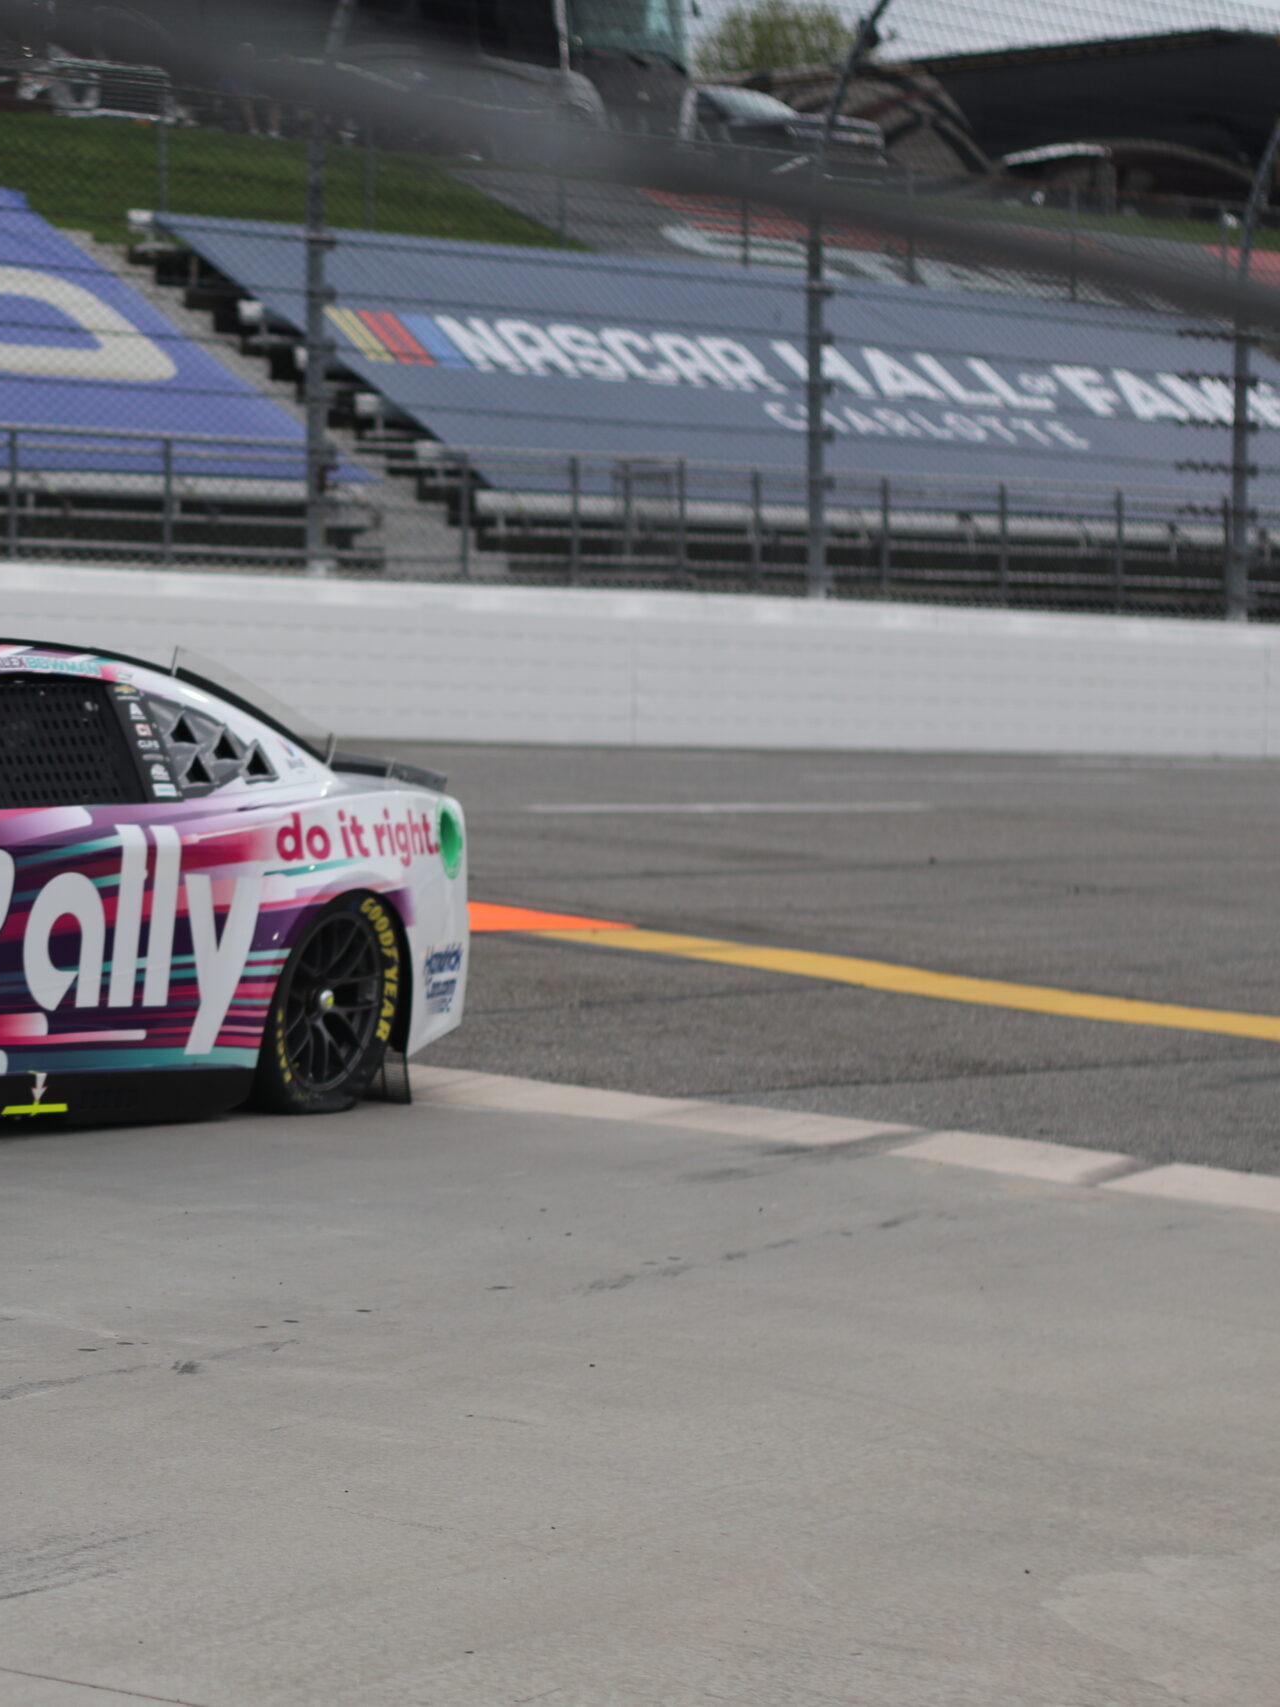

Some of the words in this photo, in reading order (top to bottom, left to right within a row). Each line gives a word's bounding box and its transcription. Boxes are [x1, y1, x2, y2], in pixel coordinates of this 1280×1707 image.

[433, 314, 789, 394] NASCAR
[770, 339, 1057, 411] HALL
[763, 401, 1090, 450] CHARLOTTE
[276, 812, 331, 862] do
[337, 809, 371, 858] it
[372, 807, 440, 868] right.
[23, 823, 263, 1056] ally
[360, 897, 399, 1042] GOODYEAR
